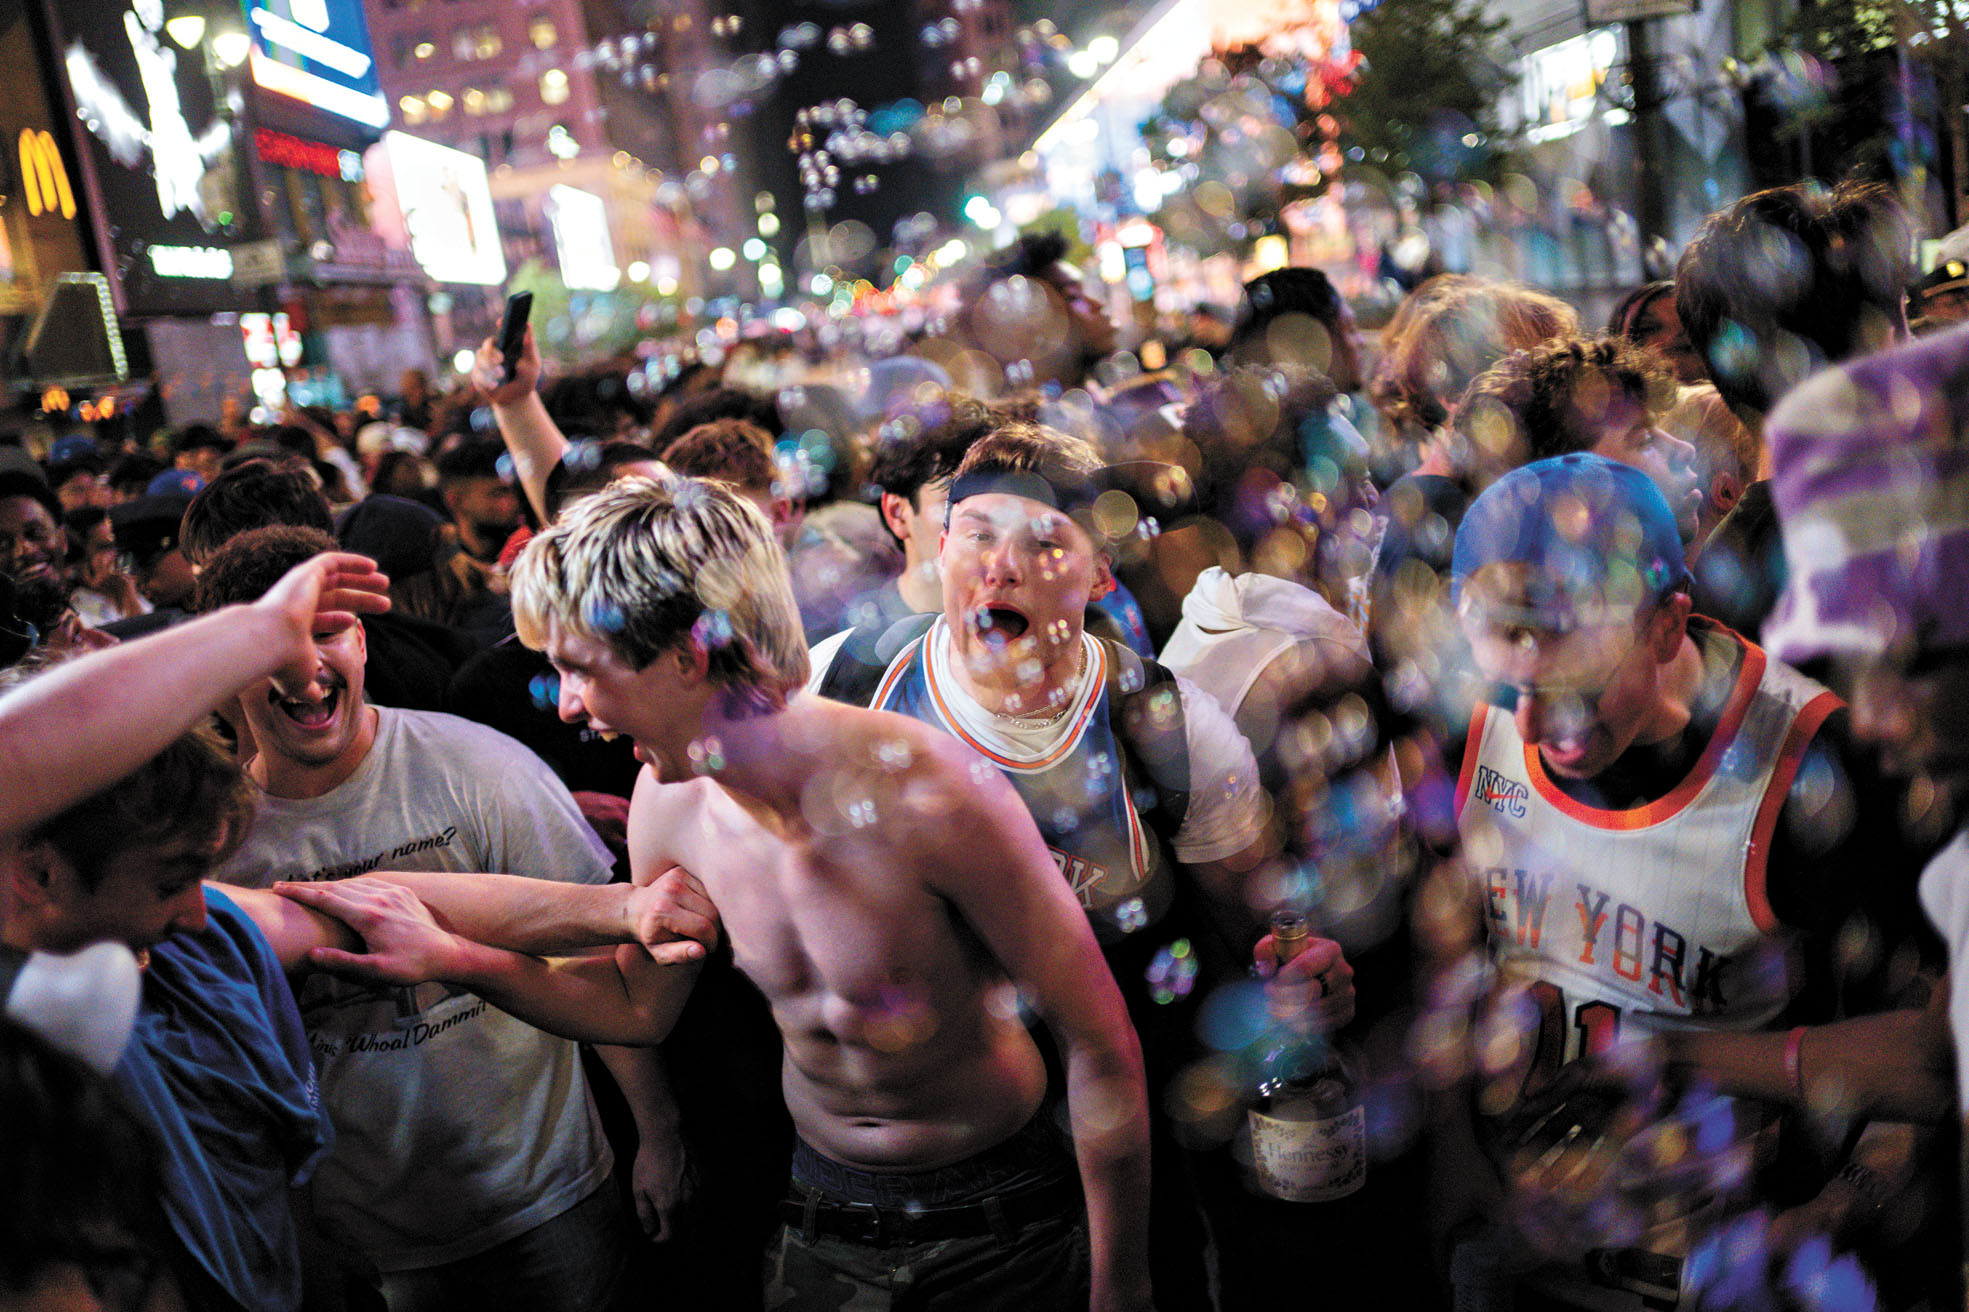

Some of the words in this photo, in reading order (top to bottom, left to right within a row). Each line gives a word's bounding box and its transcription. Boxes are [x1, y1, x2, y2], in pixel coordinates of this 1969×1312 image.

[1475, 765, 1529, 819] NYC
[391, 825, 457, 860] name?
[1485, 866, 1554, 950] EW
[1574, 882, 1732, 1010] YORK
